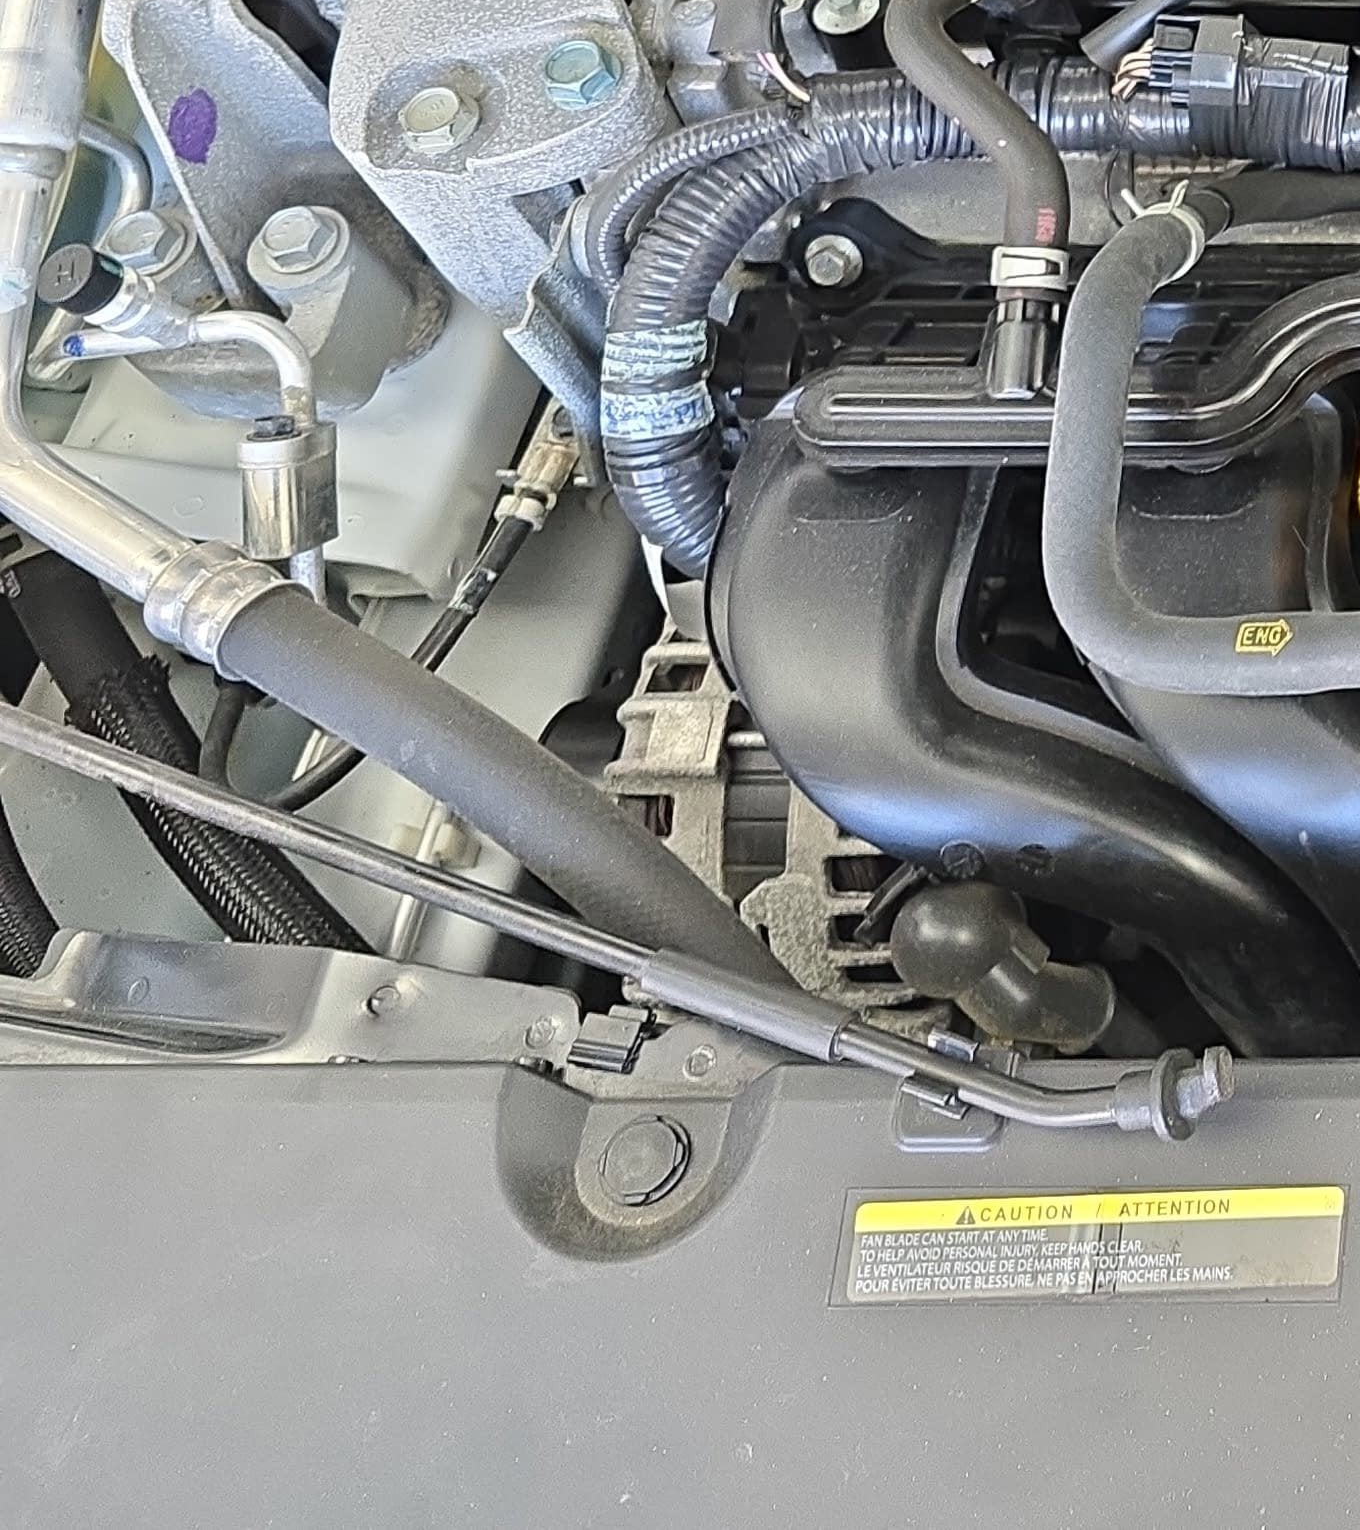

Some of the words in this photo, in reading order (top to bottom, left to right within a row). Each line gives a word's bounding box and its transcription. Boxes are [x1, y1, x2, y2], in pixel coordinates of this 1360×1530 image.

[1242, 626, 1282, 645] ENG
[980, 1203, 1074, 1222] CAUTION
[1119, 1198, 1232, 1216] ATTENTION
[861, 1234, 882, 1247] FAN
[884, 1233, 921, 1246] BLADE
[922, 1232, 946, 1245] CAN
[947, 1231, 980, 1244] START
[981, 1230, 997, 1243] AT
[998, 1230, 1021, 1243] ANY
[860, 1249, 875, 1262] TO
[876, 1248, 905, 1262] HELP
[906, 1247, 941, 1261] AVOID
[942, 1245, 998, 1259] PERSONAL
[1041, 1243, 1067, 1256] KEEP
[1069, 1241, 1105, 1255] HANDS
[858, 1265, 873, 1278] LE
[873, 1261, 951, 1277] VENTILATEUR
[954, 1260, 997, 1275] RISQUE
[999, 1259, 1016, 1272] DE
[1093, 1255, 1125, 1269] TOUT
[1127, 1254, 1183, 1268] MOMENT.
[855, 1280, 889, 1294] POUR
[932, 1276, 972, 1291] TOUTE
[1037, 1273, 1054, 1287] NE
[1056, 1272, 1076, 1286] PAS
[1077, 1270, 1094, 1285] EN
[1096, 1269, 1168, 1285] APPROCHER
[1170, 1268, 1190, 1282] LES
[1192, 1265, 1234, 1280] MAINS.
